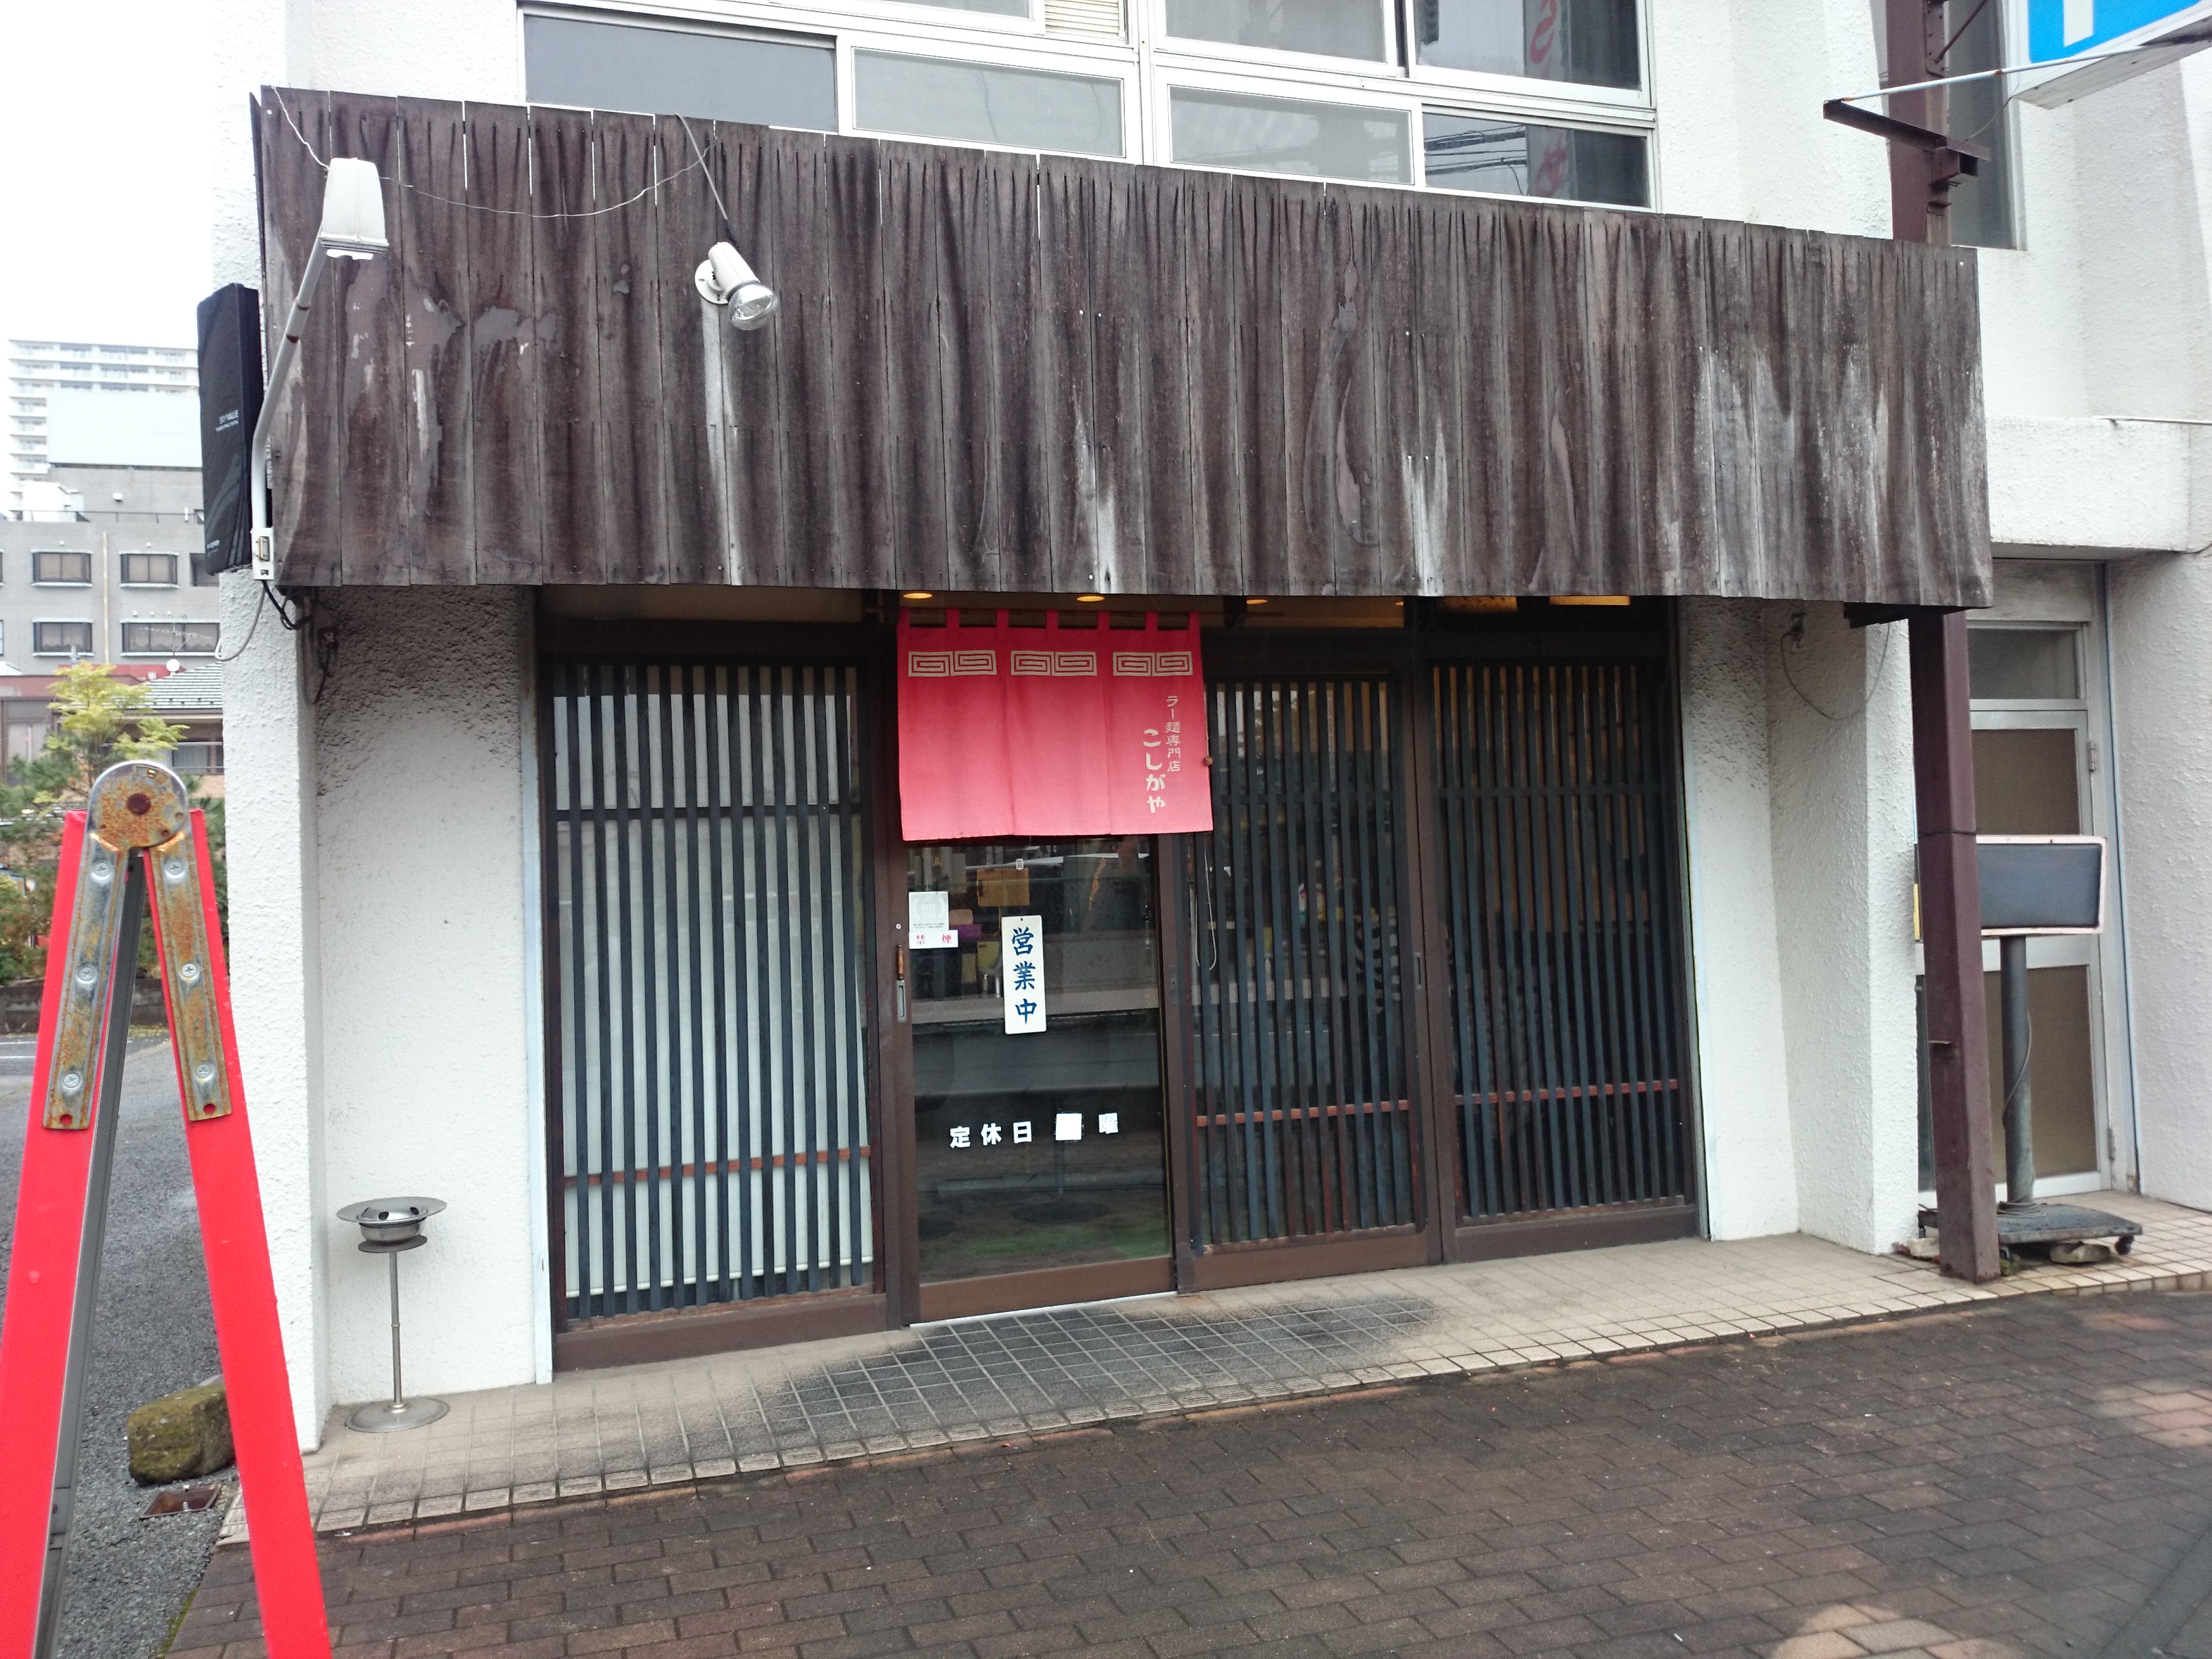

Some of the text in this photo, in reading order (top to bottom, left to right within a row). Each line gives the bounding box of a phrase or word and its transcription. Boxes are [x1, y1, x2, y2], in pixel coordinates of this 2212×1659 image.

[1143, 729, 1166, 814] こしがや
[1165, 695, 1181, 773] ラー麺専門店
[1012, 926, 1038, 1025] 営業中
[949, 1121, 1033, 1149] 定休日
